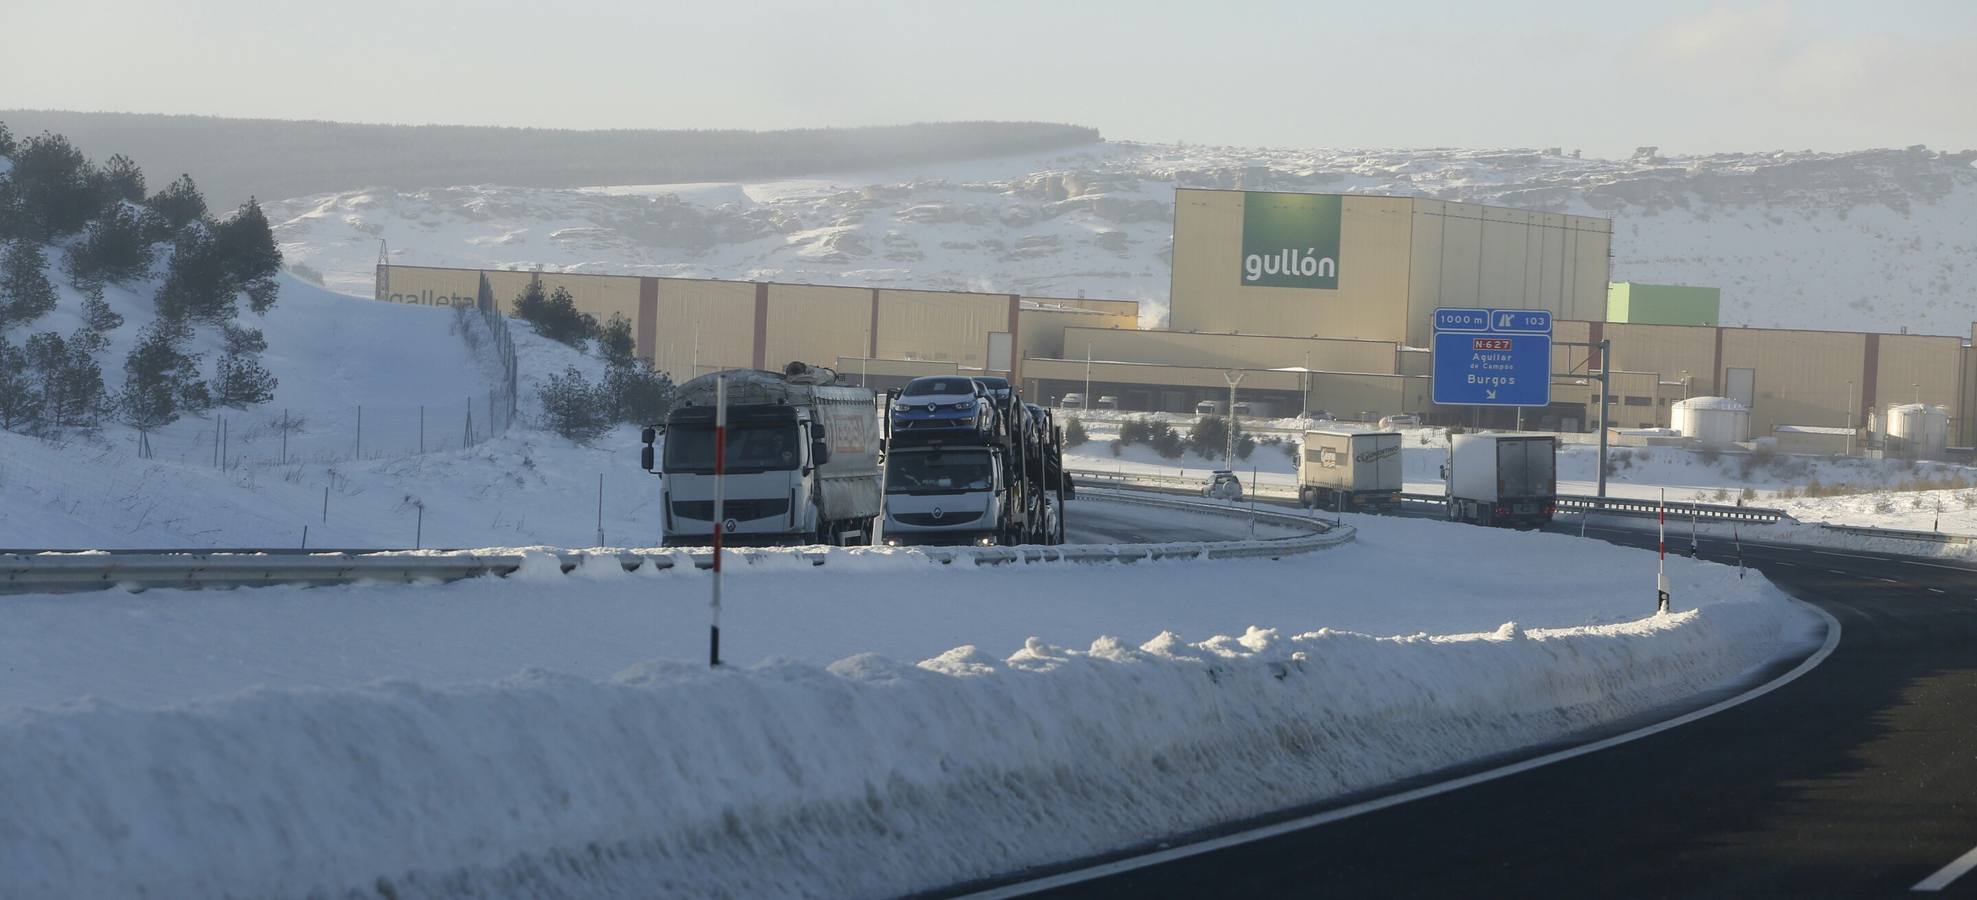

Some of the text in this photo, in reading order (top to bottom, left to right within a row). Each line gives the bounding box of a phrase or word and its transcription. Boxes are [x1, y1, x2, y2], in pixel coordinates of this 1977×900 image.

[1245, 247, 1335, 281] gullón
[1440, 315, 1483, 325] 1000 m
[1525, 317, 1545, 326] 103
[1475, 340, 1509, 349] N-627
[1472, 353, 1512, 363] Aguilar
[1467, 374, 1516, 388] Burgos
